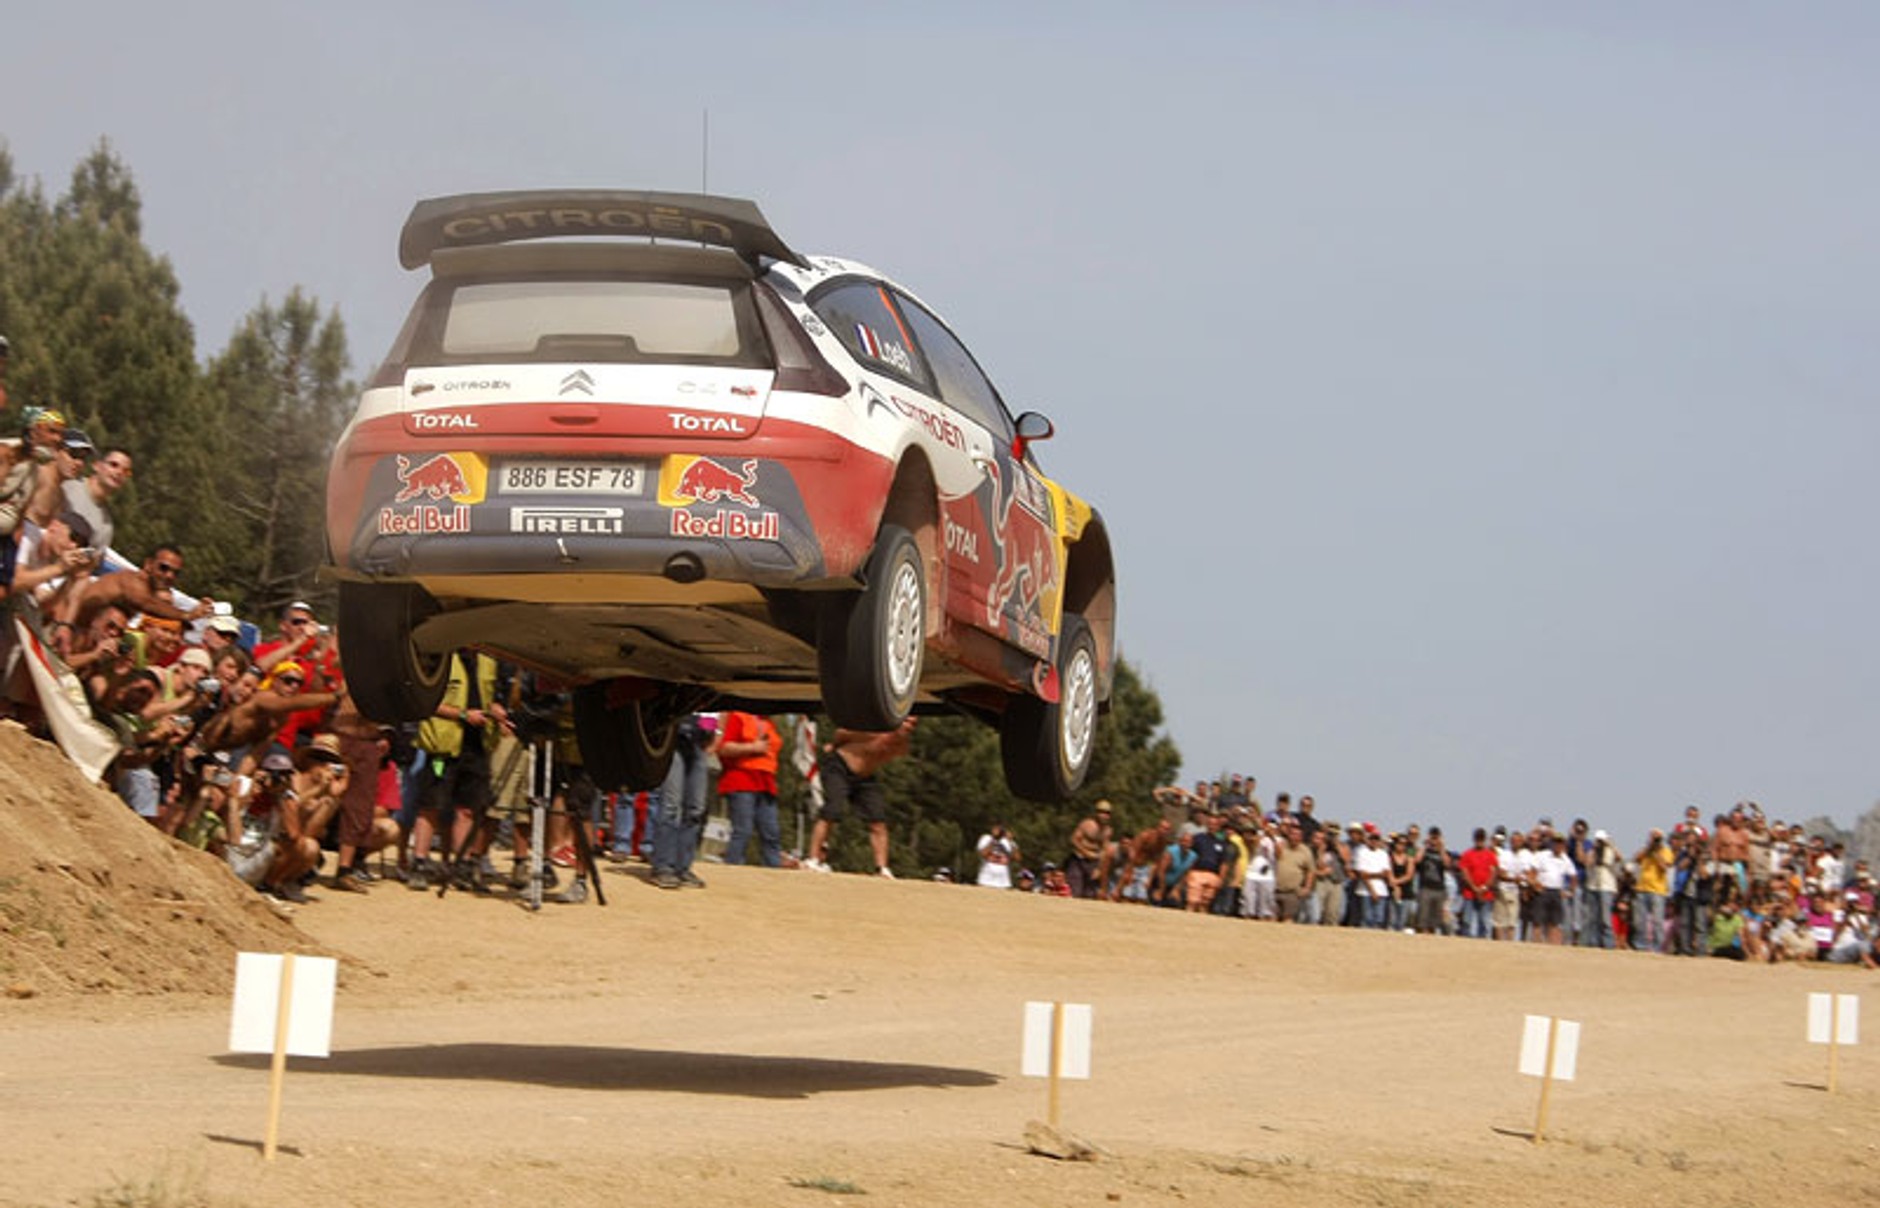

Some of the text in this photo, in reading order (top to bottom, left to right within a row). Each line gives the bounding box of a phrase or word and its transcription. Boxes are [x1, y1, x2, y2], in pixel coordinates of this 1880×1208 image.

[411, 413, 479, 428] TOTAL
[668, 413, 746, 433] TOTAL
[508, 467, 635, 489] 886 ESF 78
[379, 506, 471, 534] Red Bull
[510, 506, 624, 533] PIRELLI
[670, 509, 779, 540] Red Bull
